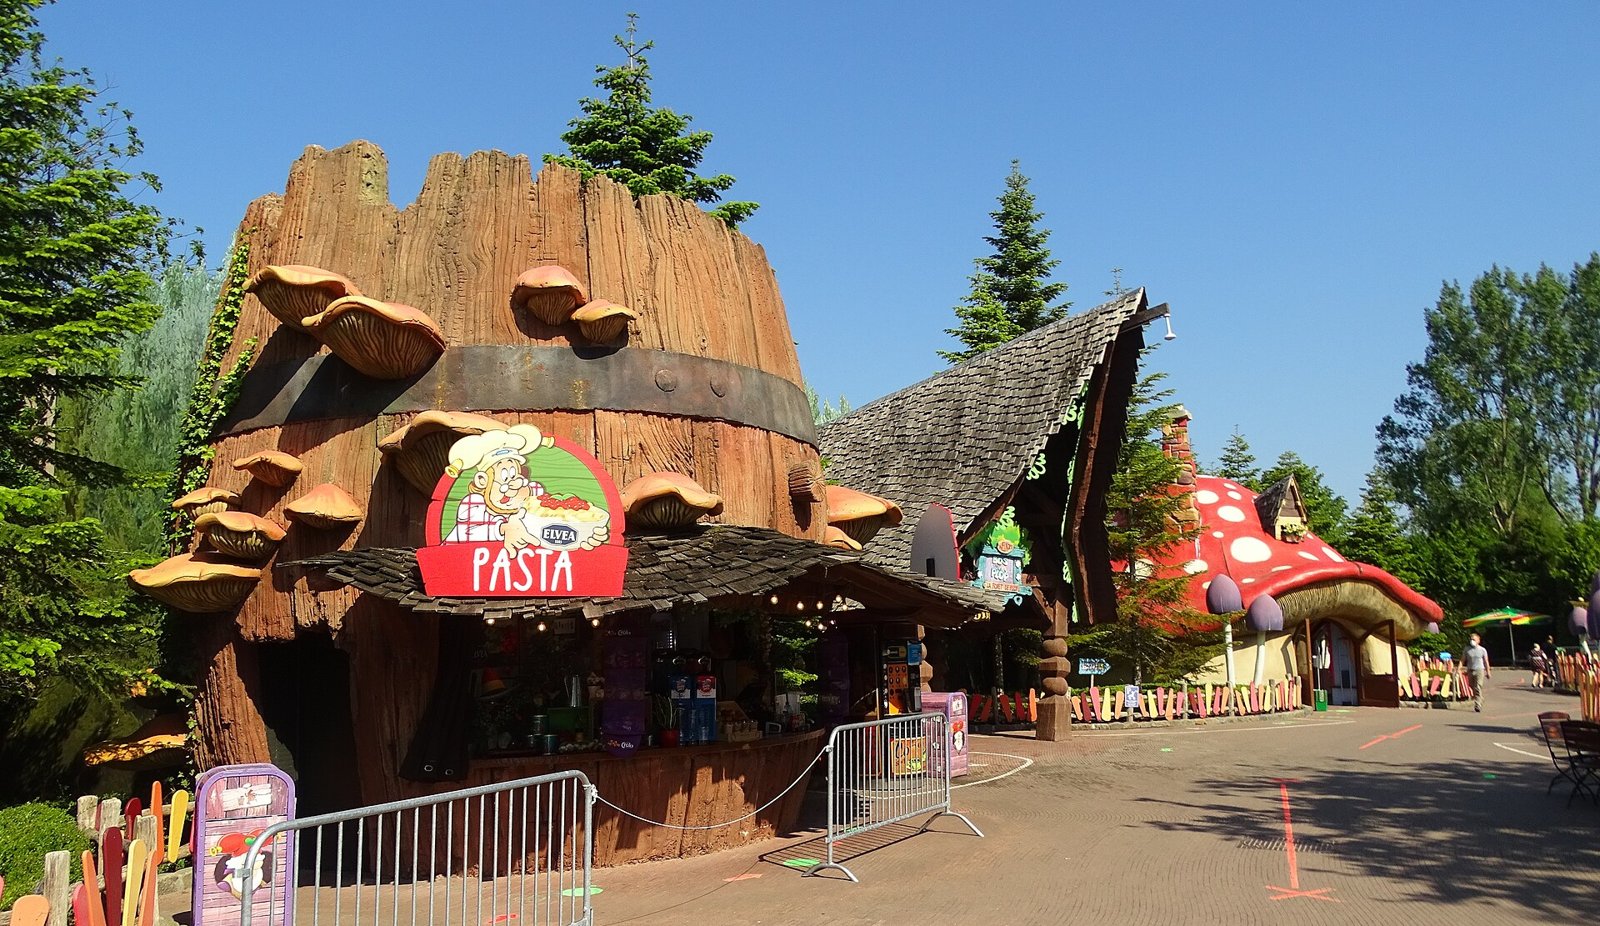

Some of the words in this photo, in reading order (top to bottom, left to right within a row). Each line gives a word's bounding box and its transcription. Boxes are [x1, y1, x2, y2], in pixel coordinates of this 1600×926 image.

[543, 528, 576, 541] ELVEA
[992, 556, 1009, 566] BOS
[473, 547, 573, 592] PASTA
[991, 568, 1009, 582] PLOP
